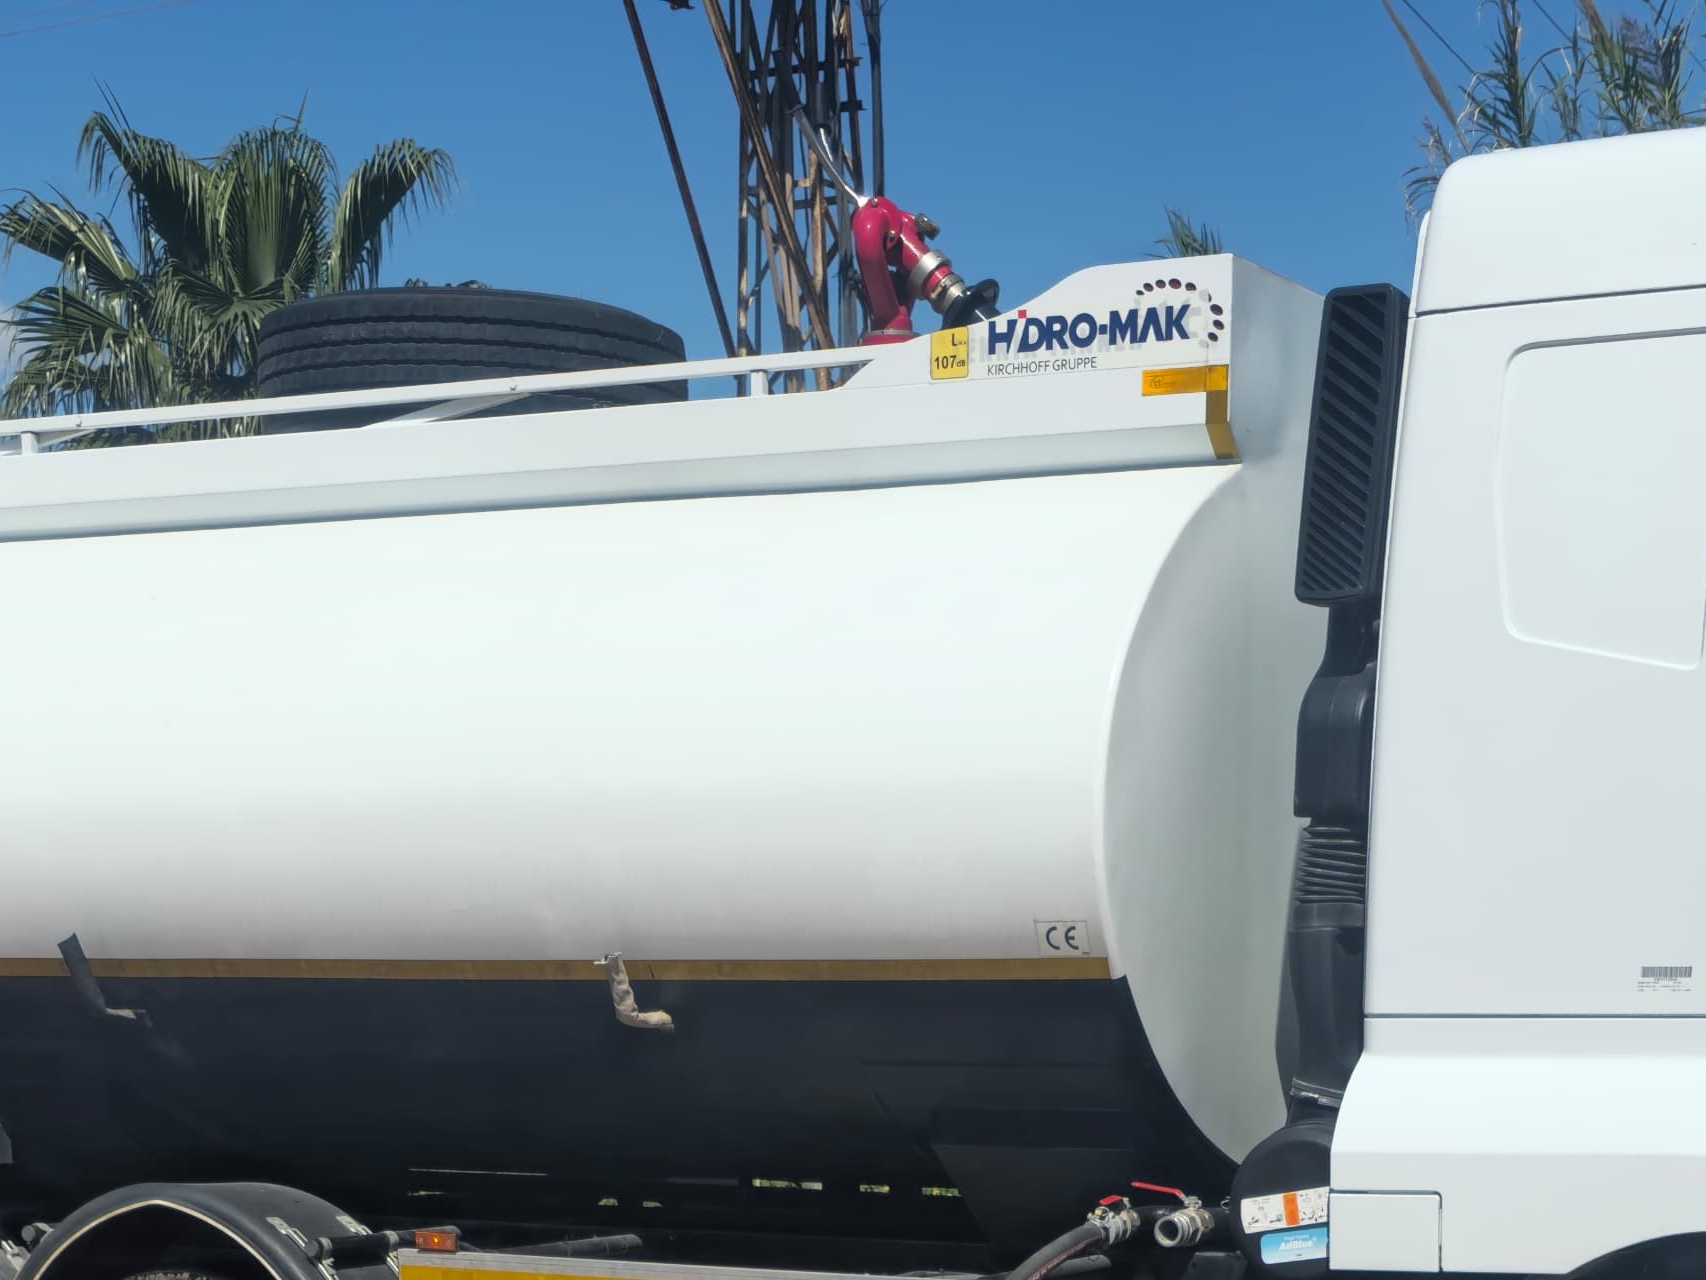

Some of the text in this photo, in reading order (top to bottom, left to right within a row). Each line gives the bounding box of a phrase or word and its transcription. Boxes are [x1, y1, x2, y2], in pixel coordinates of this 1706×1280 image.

[987, 356, 1098, 377] KIRCHHOFF GRUPPE
[1045, 925, 1080, 951] CE
